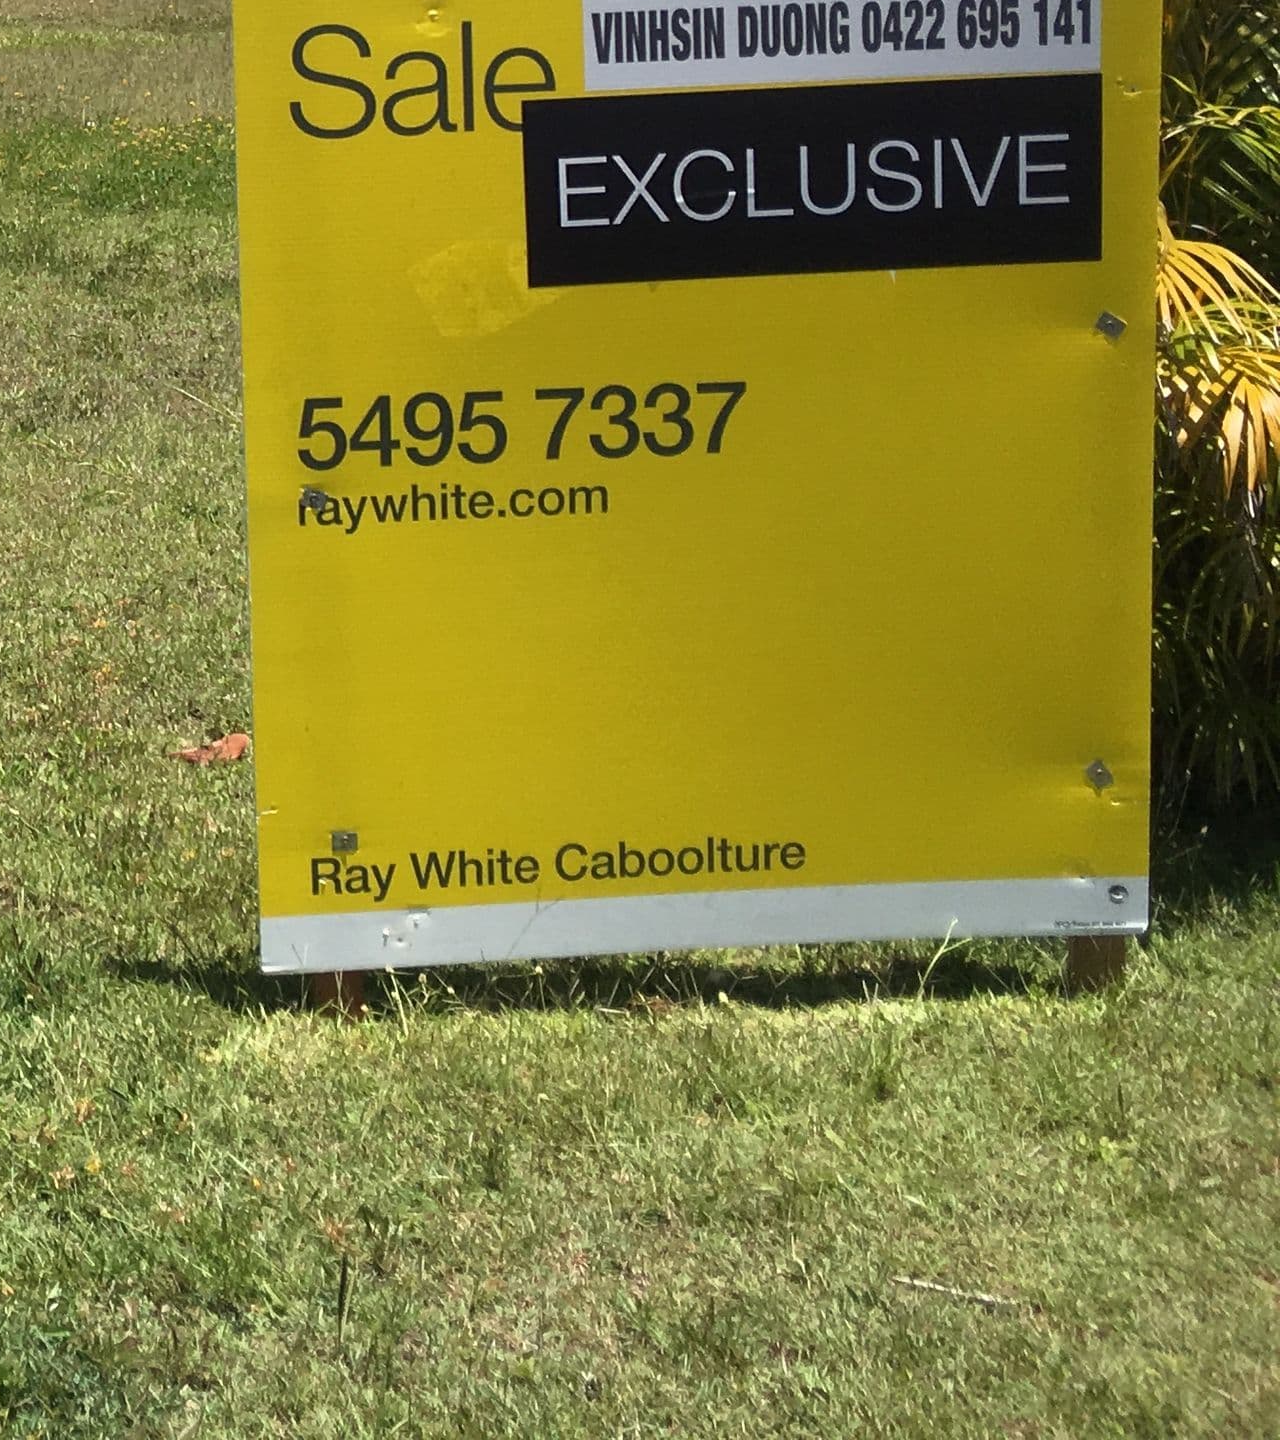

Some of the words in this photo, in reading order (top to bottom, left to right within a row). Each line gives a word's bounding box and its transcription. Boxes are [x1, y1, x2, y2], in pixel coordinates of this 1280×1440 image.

[591, 6, 726, 64] VINHSIN
[737, 0, 851, 58] DUONG
[289, 20, 557, 140] Sale
[557, 133, 1070, 228] EXCLUSIVE
[297, 390, 508, 472] 5495
[534, 381, 747, 460] 7337
[310, 857, 397, 903] Ray
[409, 849, 540, 890] White
[554, 836, 806, 882] Caboolture
